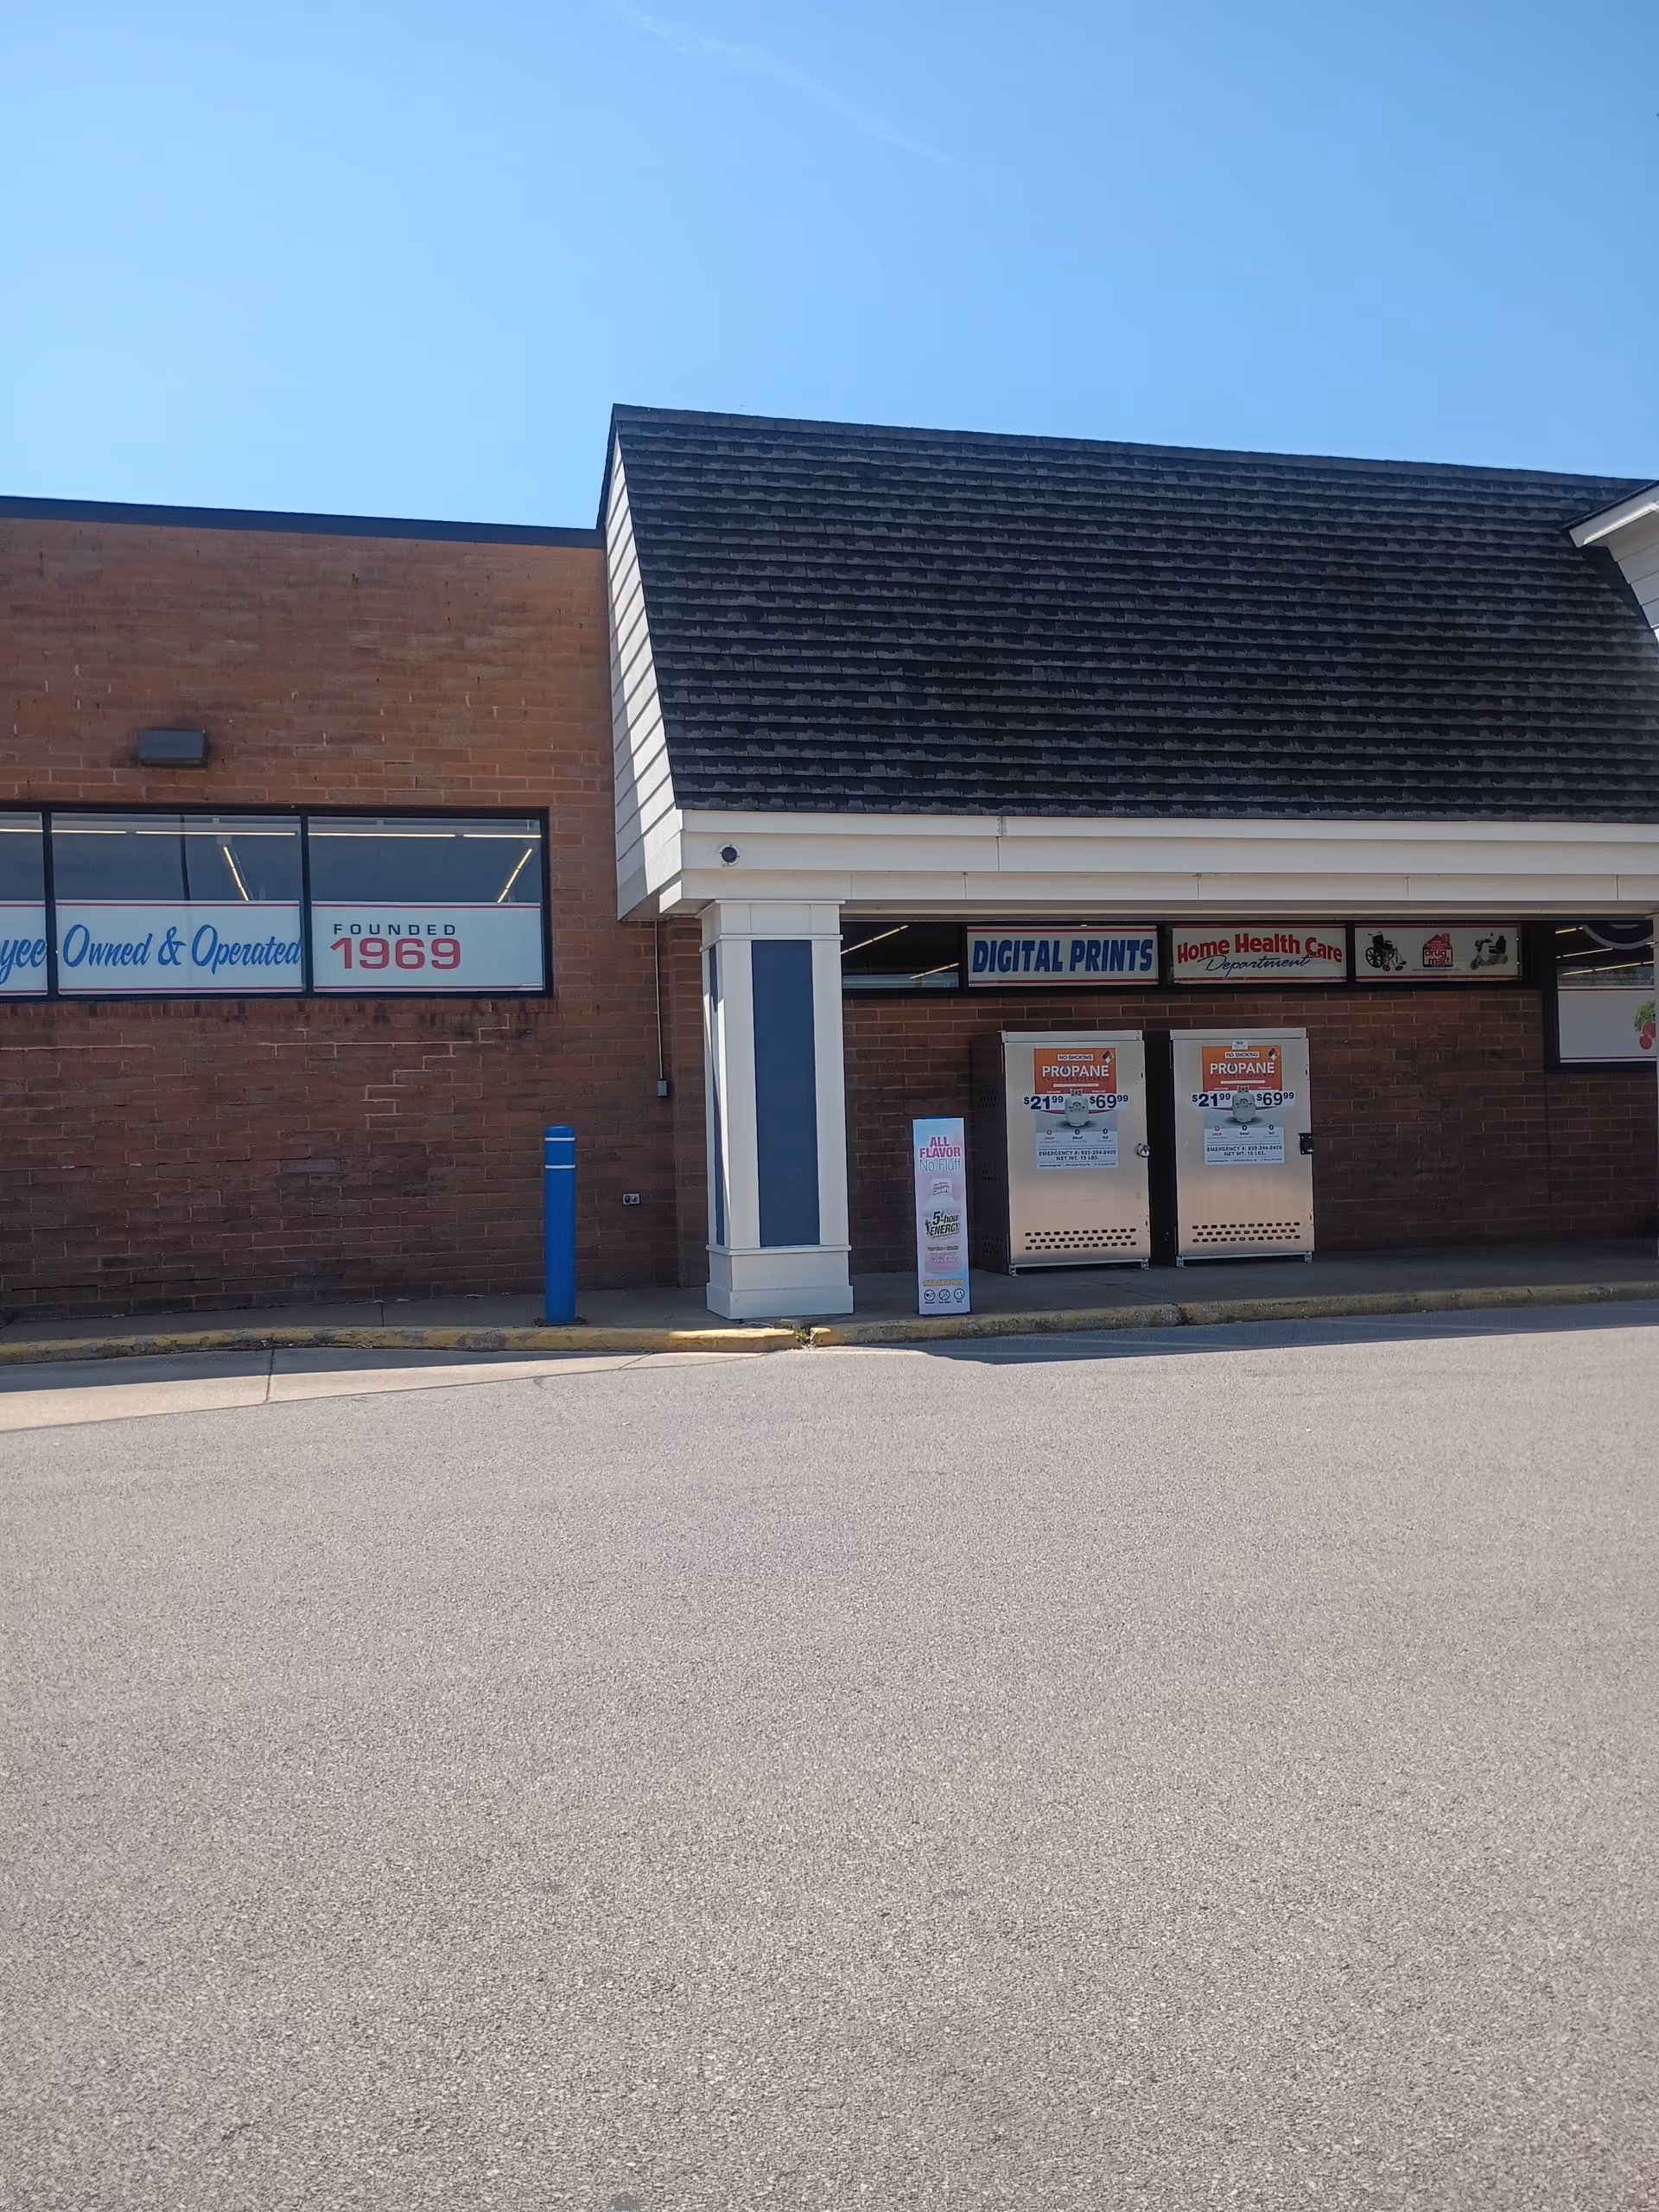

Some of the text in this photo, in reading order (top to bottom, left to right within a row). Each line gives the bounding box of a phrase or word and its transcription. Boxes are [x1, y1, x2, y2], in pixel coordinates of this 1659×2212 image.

[334, 924, 457, 936] FOUNDED
[64, 925, 150, 968] Owned
[158, 926, 183, 967] &
[192, 925, 303, 975] Operated
[330, 938, 461, 969] 1969
[1177, 933, 1343, 964] Home Health Care
[1425, 948, 1447, 959] drug
[972, 938, 1154, 973] DIGITAL PRINTS
[1428, 956, 1451, 965] mart
[1197, 953, 1320, 979] Department
[1042, 1065, 1109, 1077] PROPANE
[1210, 1062, 1275, 1075] PROPANE
[930, 1136, 950, 1147] ALL
[919, 1147, 961, 1158] FLAVOR
[919, 1158, 962, 1172] No Fluff
[932, 1211, 960, 1225] 5-hour
[930, 1223, 960, 1236] ENERGY
